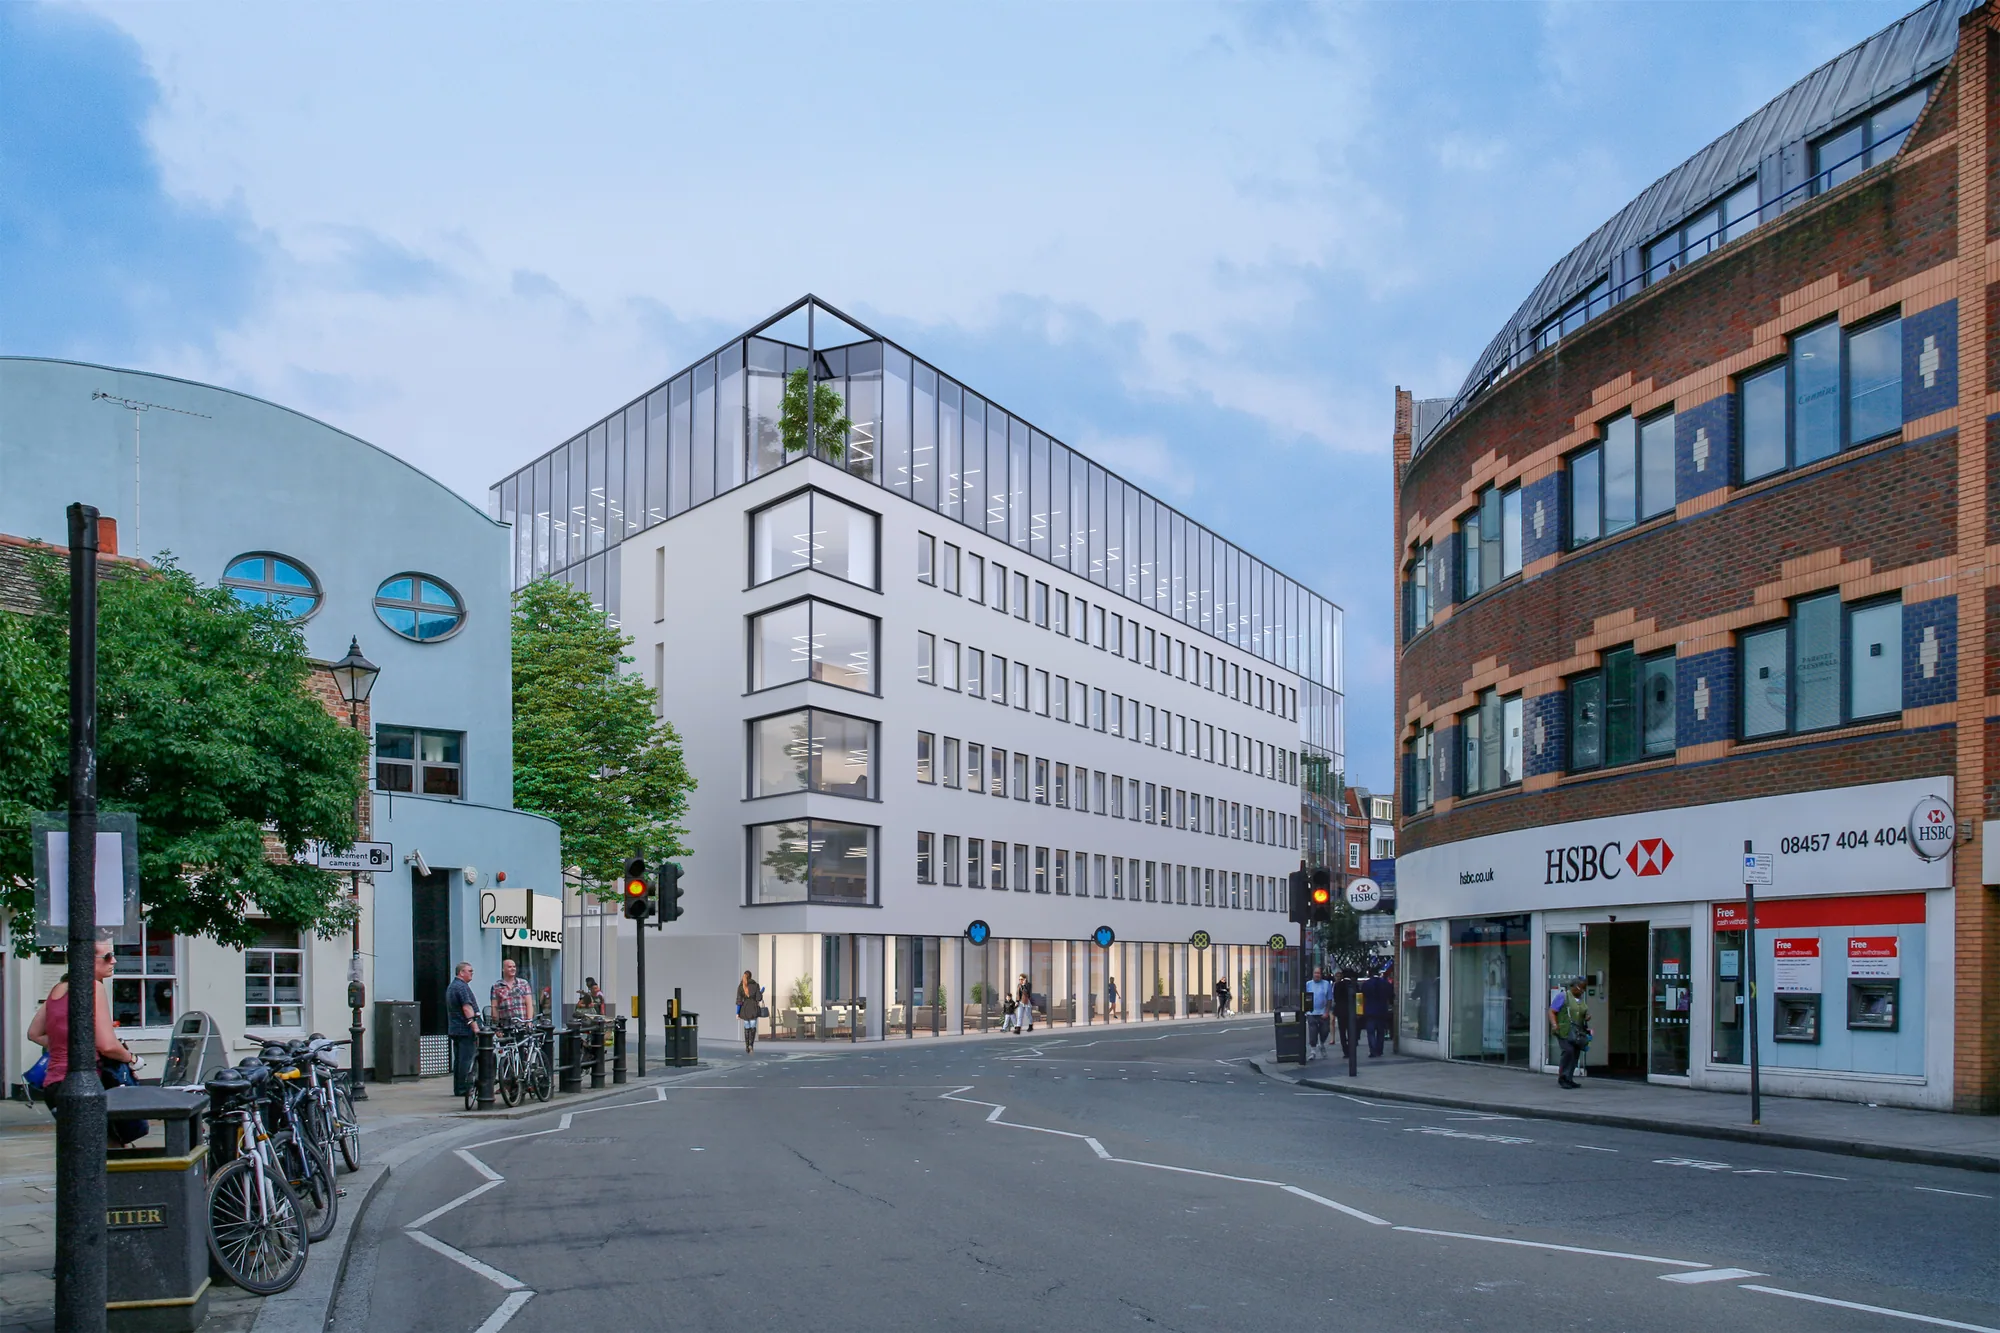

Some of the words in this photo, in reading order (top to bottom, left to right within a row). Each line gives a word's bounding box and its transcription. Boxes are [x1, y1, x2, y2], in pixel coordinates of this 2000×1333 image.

[1918, 825, 1953, 841] HSBC
[1781, 833, 1830, 854] 08457
[1836, 830, 1869, 849] 404
[1874, 826, 1908, 847] 404
[1544, 841, 1621, 885] HSBC
[1459, 868, 1495, 885] hsbc.co.uk
[1350, 892, 1378, 902] HSBC
[1717, 908, 1735, 917] Free
[496, 915, 527, 924] PUREGYM
[1777, 940, 1792, 949] Free
[1851, 940, 1867, 949] Free
[106, 1209, 162, 1225] ITTER
